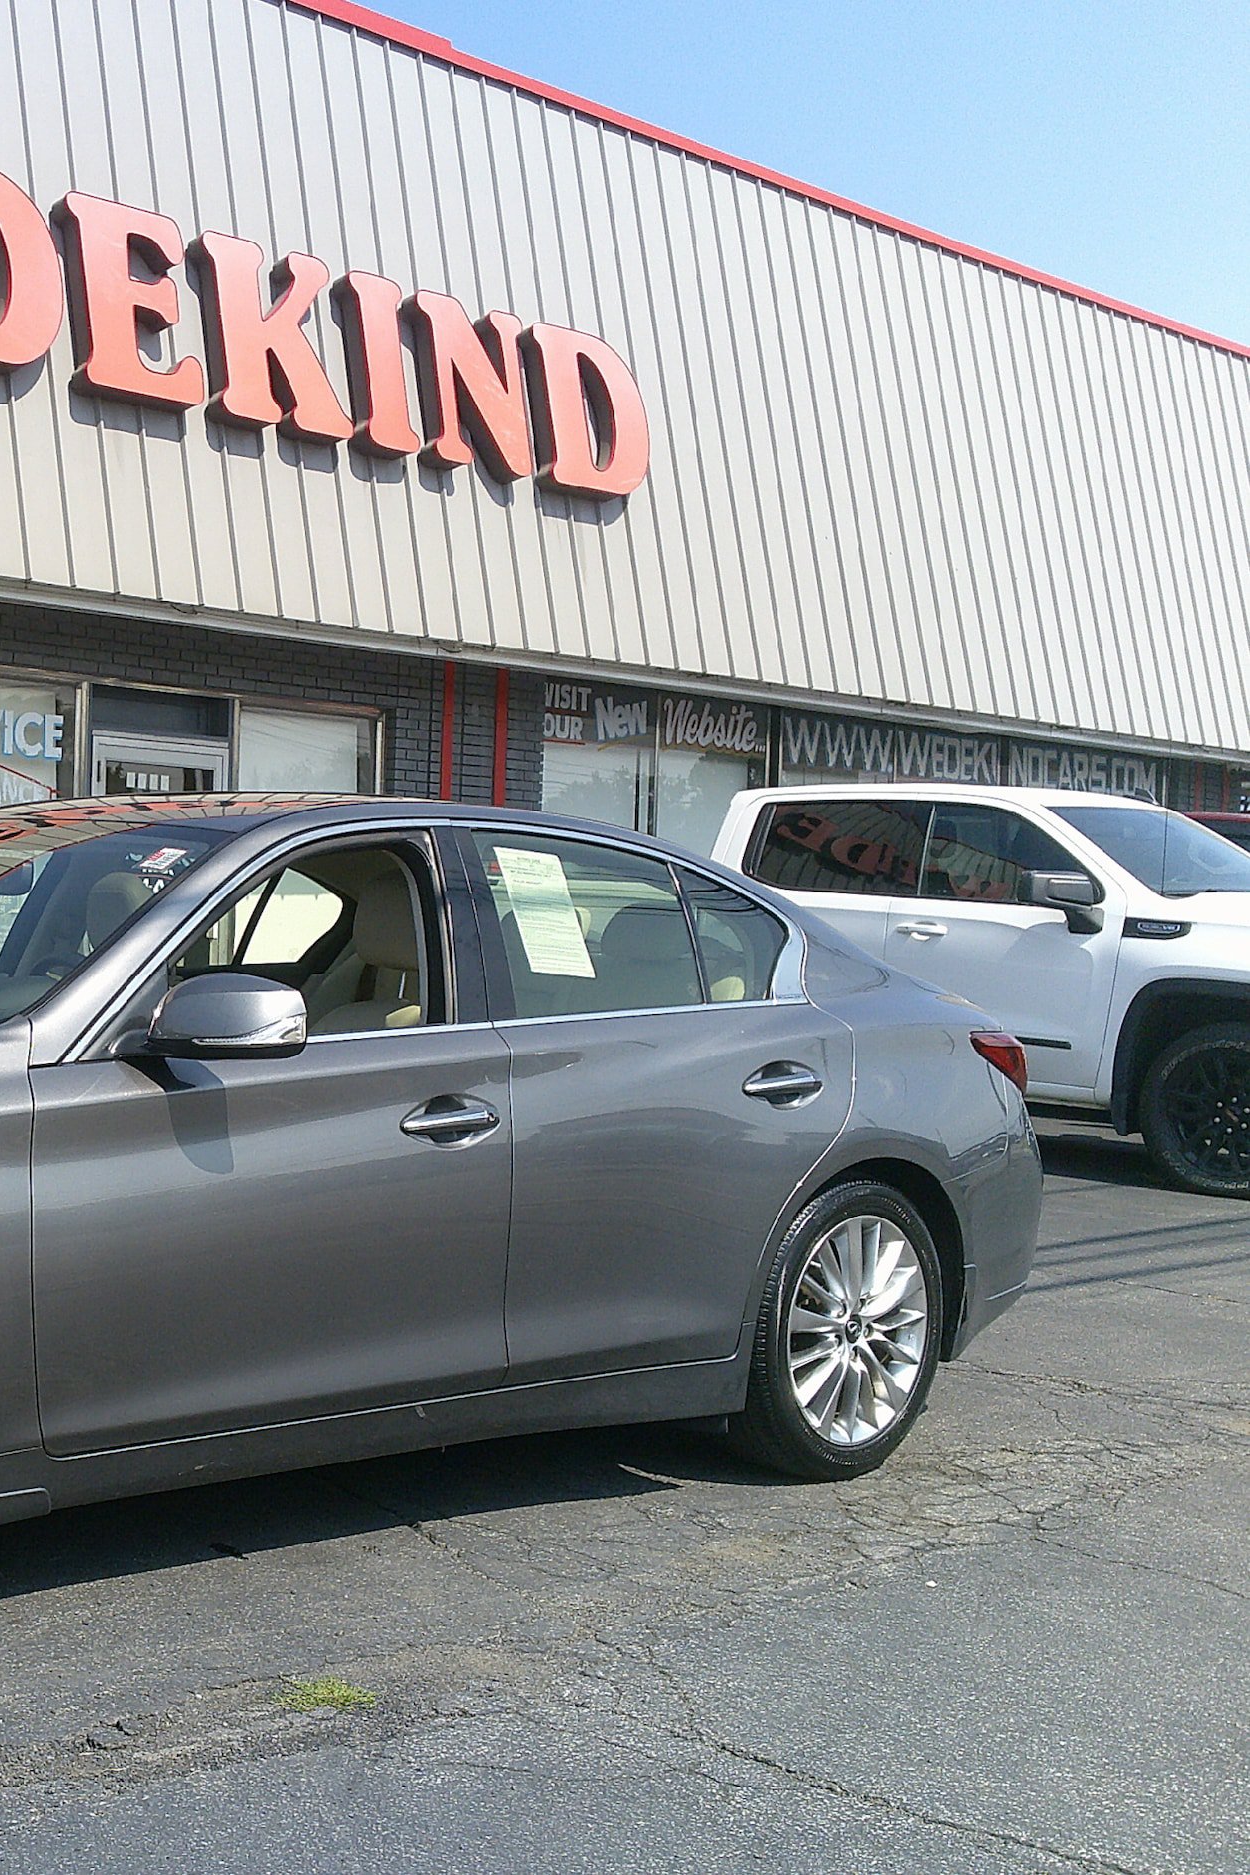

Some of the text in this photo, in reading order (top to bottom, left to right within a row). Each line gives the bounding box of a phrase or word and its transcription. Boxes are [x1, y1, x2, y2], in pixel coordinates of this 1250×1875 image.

[544, 682, 592, 711] VISIT
[543, 696, 648, 741] OUR New
